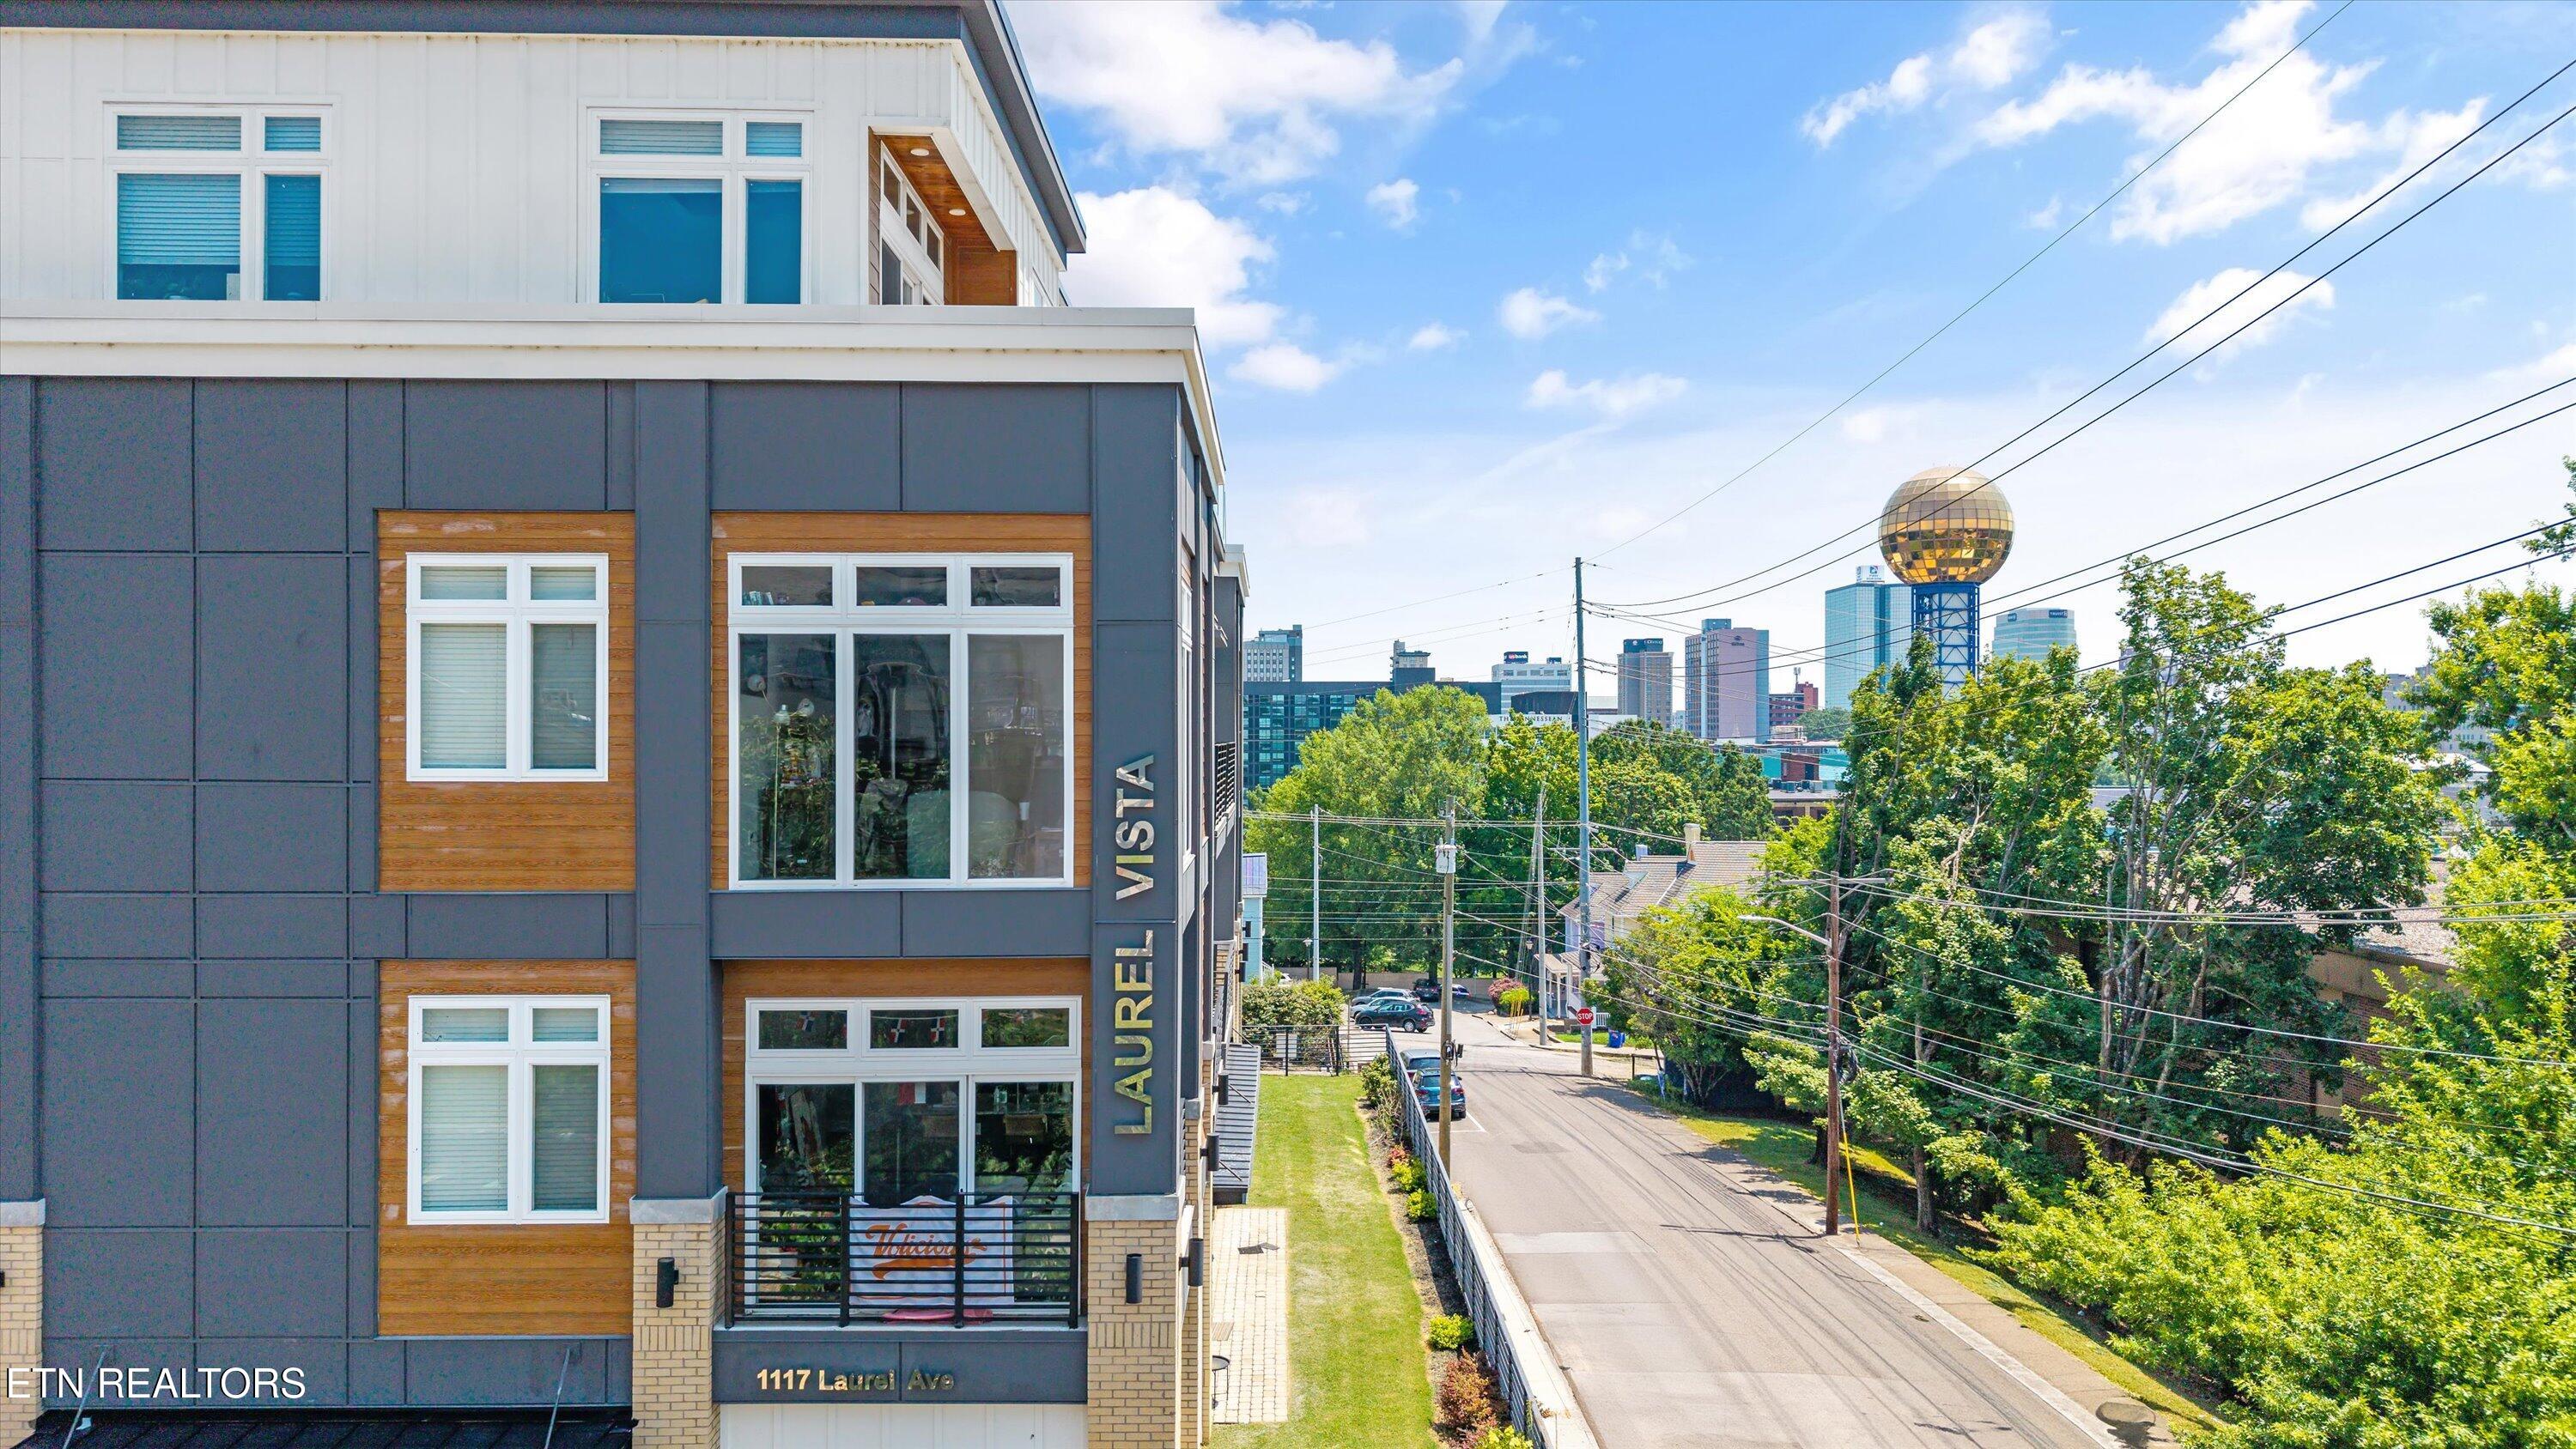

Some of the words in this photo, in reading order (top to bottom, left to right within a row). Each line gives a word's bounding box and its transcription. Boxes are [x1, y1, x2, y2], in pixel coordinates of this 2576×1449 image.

[1115, 755, 1154, 900] VISTA
[1114, 930, 1153, 1135] LAUREL
[756, 1368, 811, 1390] 1117
[818, 1368, 896, 1391] Laurel
[907, 1368, 954, 1391] Ave
